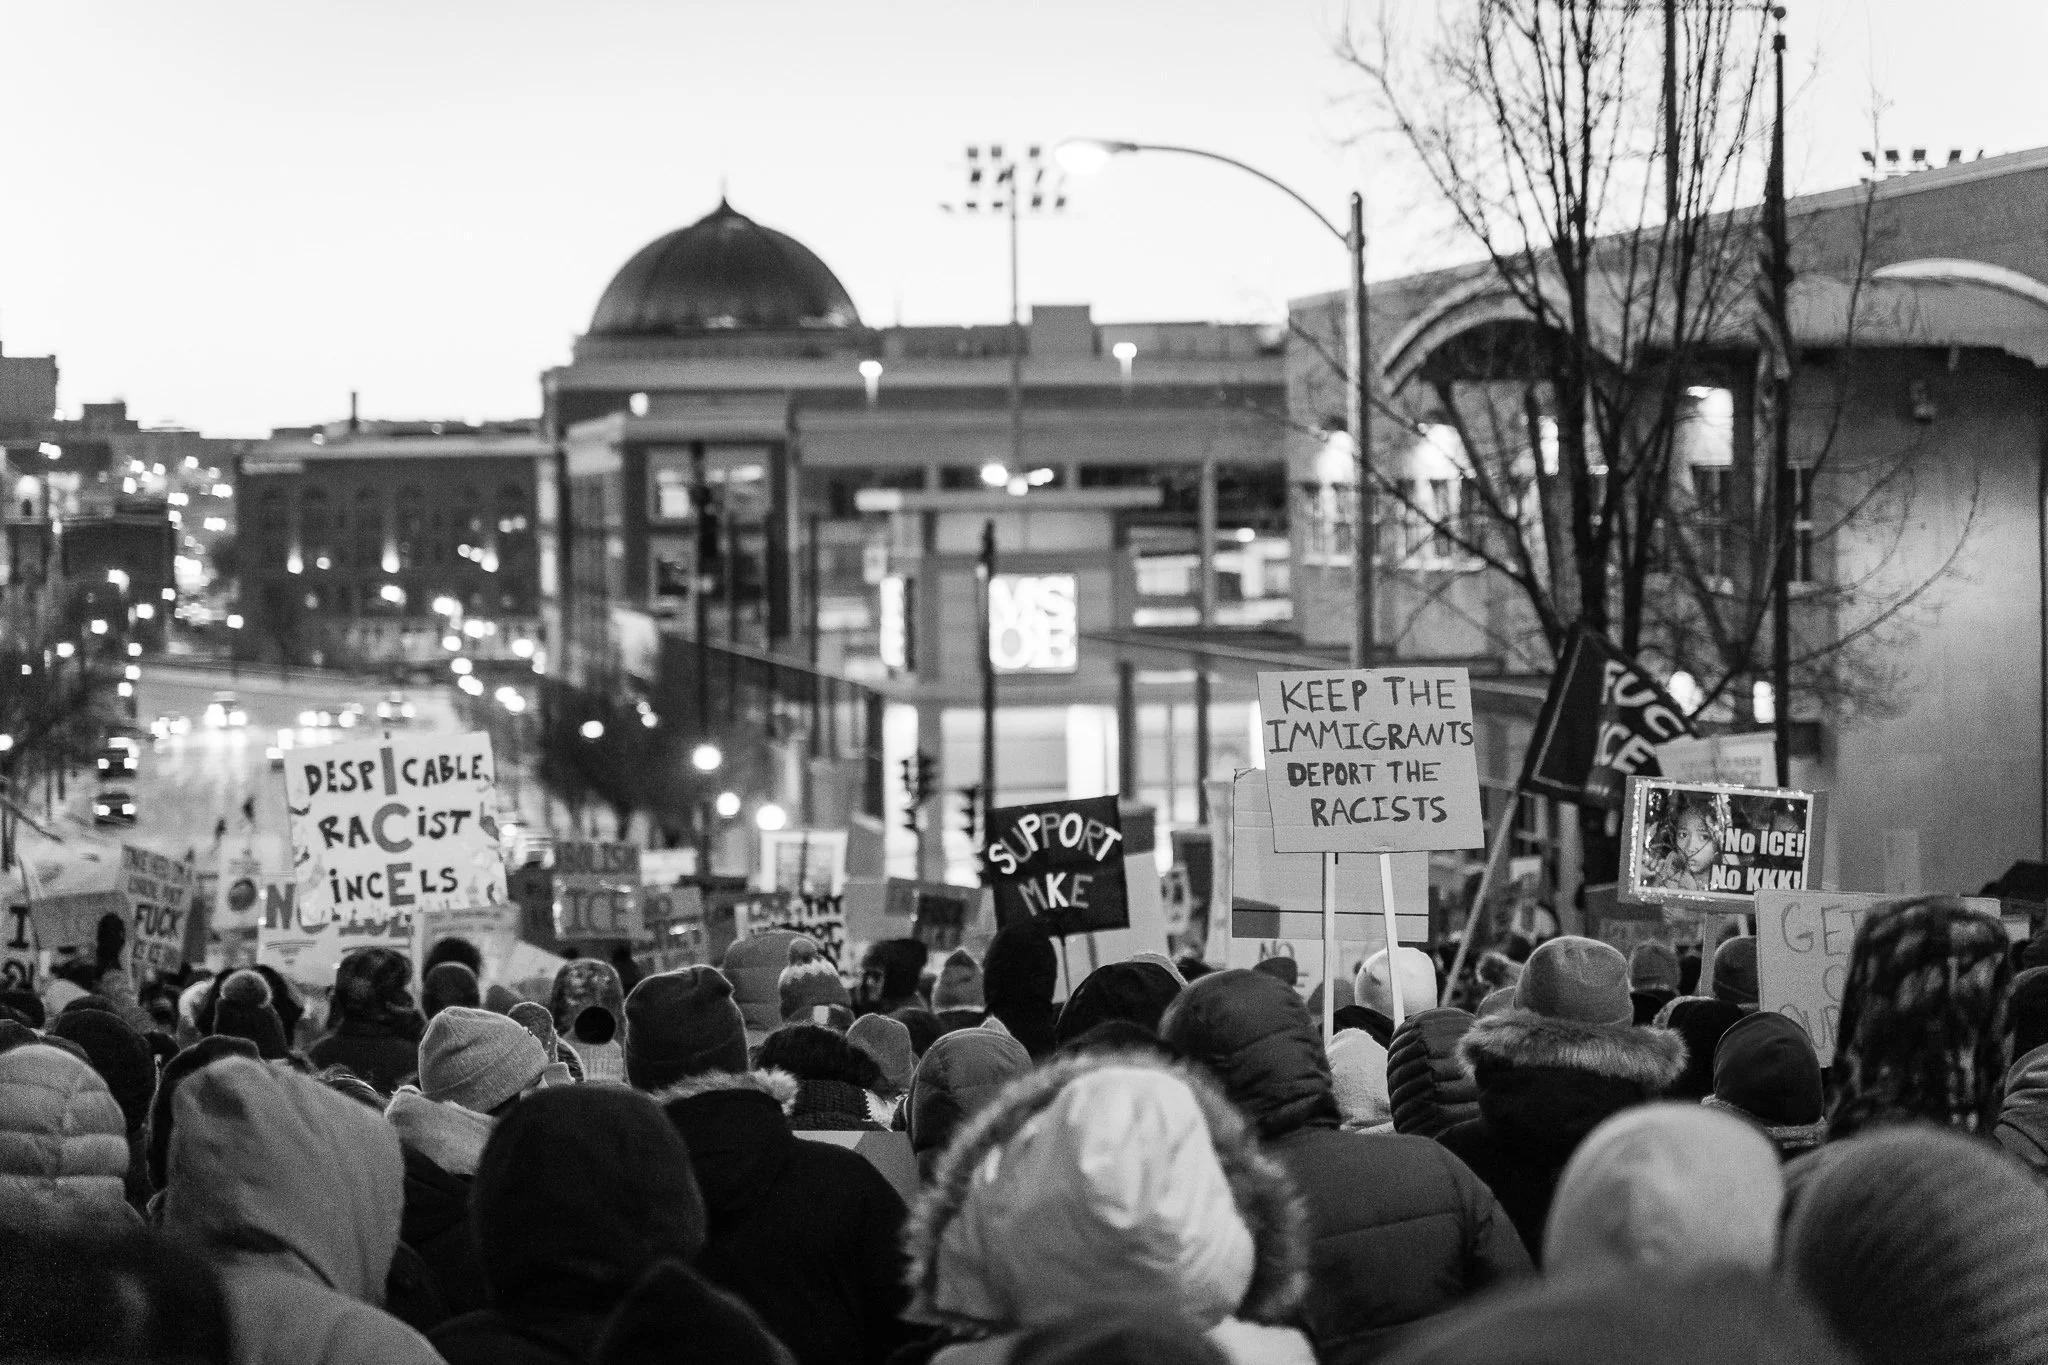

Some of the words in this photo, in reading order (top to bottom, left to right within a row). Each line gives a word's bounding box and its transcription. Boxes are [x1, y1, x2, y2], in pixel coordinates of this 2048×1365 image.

[1280, 679, 1368, 714] KEEP
[1383, 676, 1456, 709] THE
[1601, 658, 1686, 739] FUC
[1266, 719, 1474, 754] IMMIGRANTS
[1287, 761, 1376, 787] DEPORT
[1387, 760, 1442, 783] THE
[1310, 796, 1448, 827] RACISTS
[988, 812, 1122, 875] SUPPORT
[1759, 830, 1806, 857] ICE!
[1018, 871, 1094, 917] MKE
[1746, 867, 1801, 891] KKK!
[135, 903, 185, 936] FUCK
